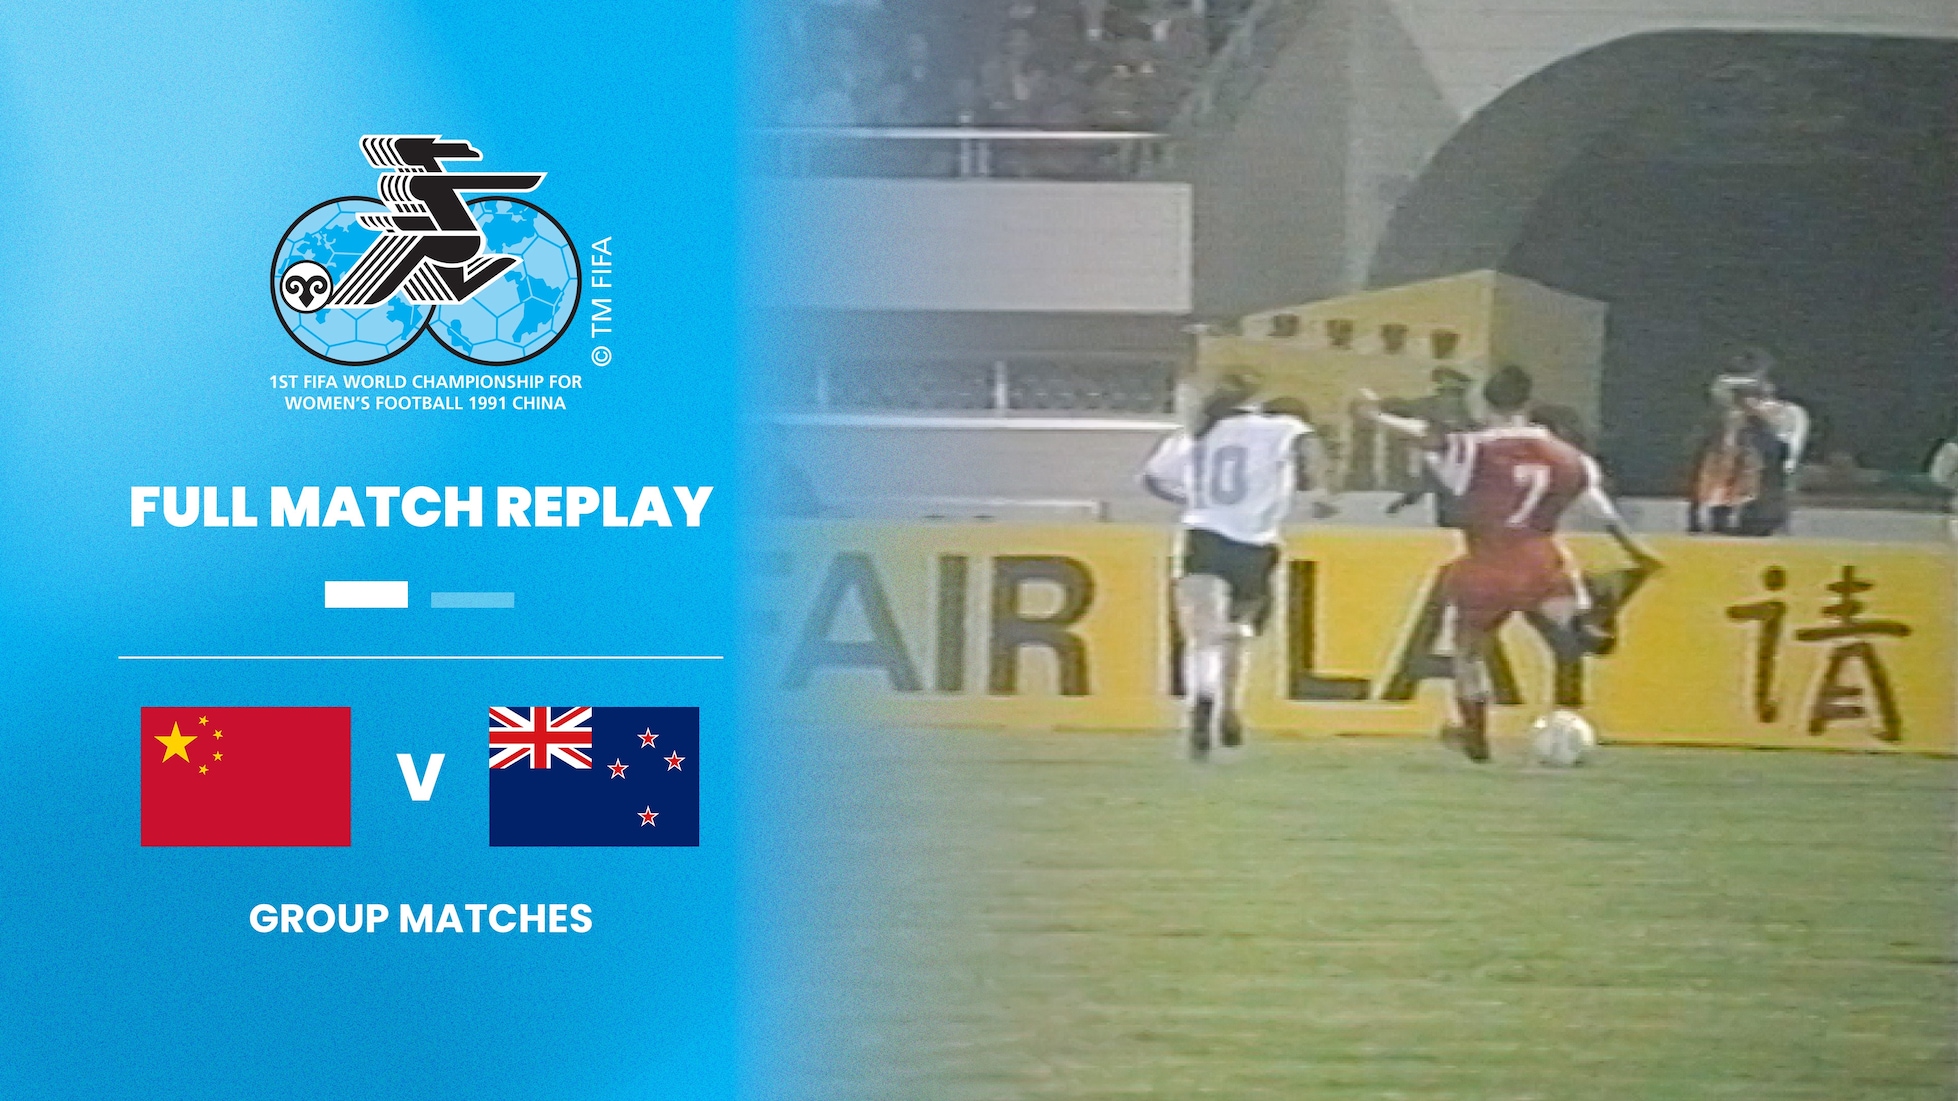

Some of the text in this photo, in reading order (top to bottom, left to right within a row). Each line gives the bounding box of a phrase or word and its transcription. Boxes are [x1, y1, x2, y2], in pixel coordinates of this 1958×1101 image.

[1193, 445, 1249, 508] 10
[1508, 464, 1552, 527] 7
[1170, 556, 1660, 705] LAY
[1726, 565, 1912, 742] 请
